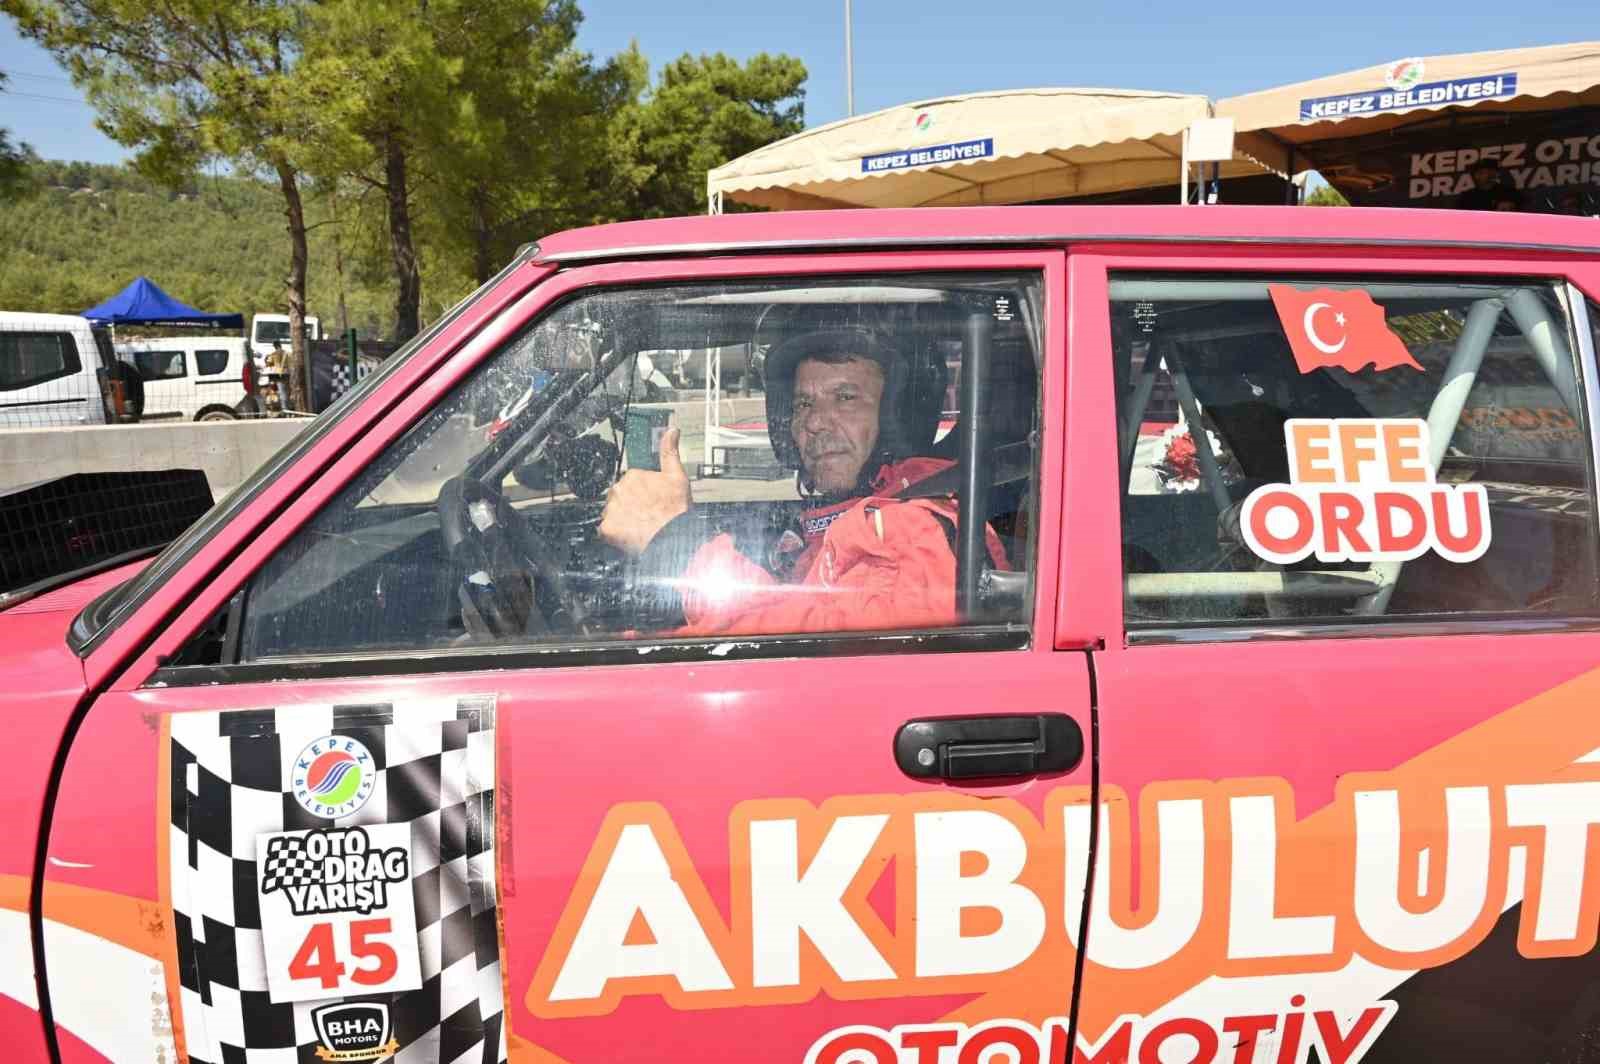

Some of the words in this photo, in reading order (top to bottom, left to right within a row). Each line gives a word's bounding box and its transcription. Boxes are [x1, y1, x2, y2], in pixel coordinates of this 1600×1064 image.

[1311, 99, 1375, 118] KEPEZ
[1380, 77, 1504, 109] BELEDİYESİ
[868, 155, 908, 170] KEPEZ
[910, 141, 986, 164] BELEDİYESİ
[1409, 173, 1482, 198] DRA
[1292, 424, 1427, 483] EFE
[1250, 491, 1483, 555] ORDU
[298, 738, 369, 770] KEPEZ
[306, 830, 367, 862] OTO
[324, 850, 405, 885] DRAG
[287, 879, 385, 913] YARIŞI
[547, 781, 1600, 1002] AKBULUT
[287, 917, 399, 990] 45
[327, 1018, 381, 1037] BHA
[335, 1034, 378, 1046] MOTORS
